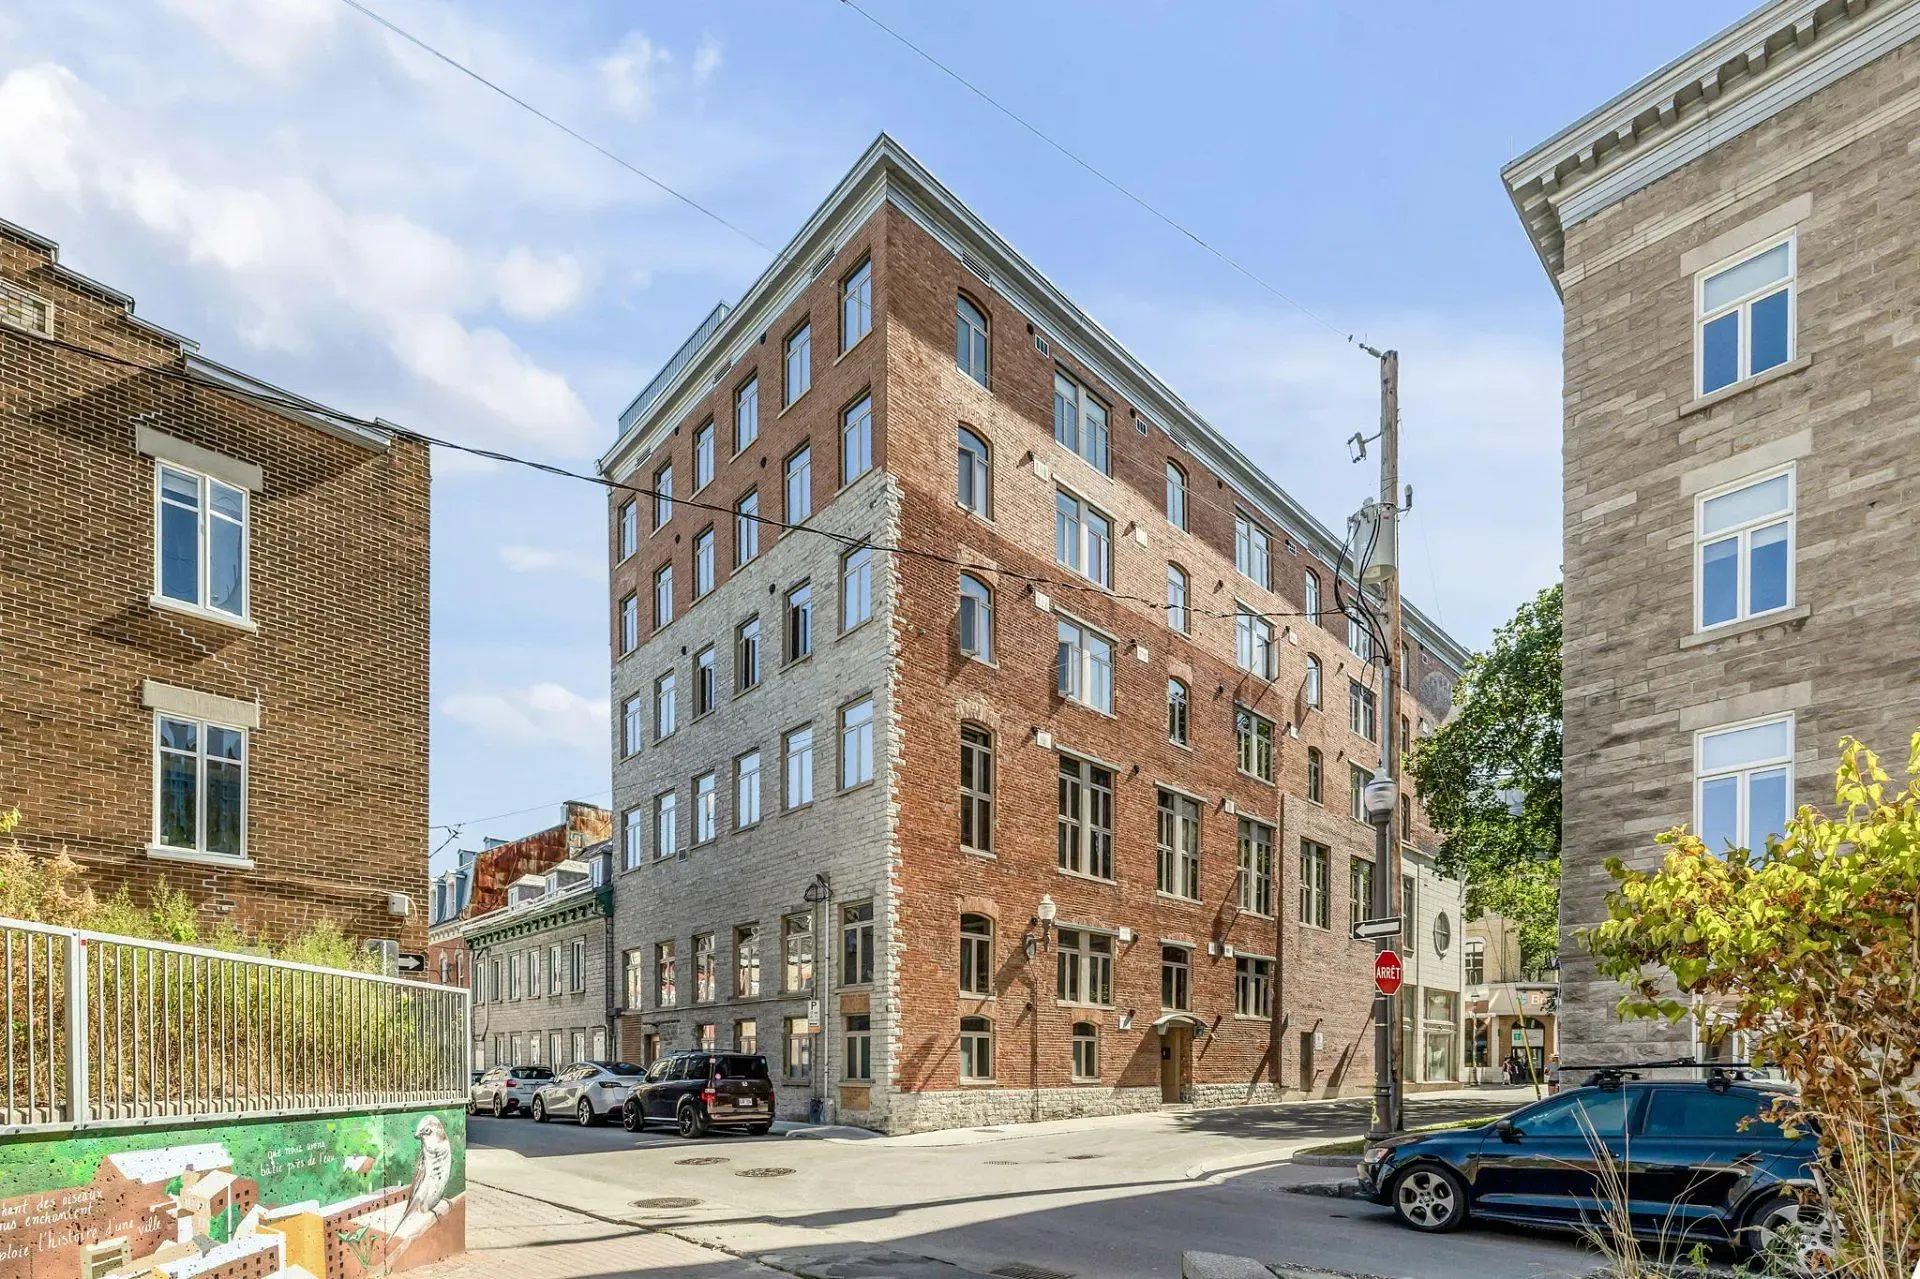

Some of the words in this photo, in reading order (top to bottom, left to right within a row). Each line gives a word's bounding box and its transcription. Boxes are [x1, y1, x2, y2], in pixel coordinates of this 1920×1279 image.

[1376, 964, 1401, 980] ARRÊT
[811, 1001, 818, 1011] P
[267, 1149, 282, 1166] que
[307, 1152, 317, 1167] de
[36, 1195, 57, 1213] des
[62, 1190, 104, 1206] oiseaux
[38, 1228, 98, 1252] l'histoire
[105, 1217, 134, 1236] d'une
[137, 1215, 161, 1236] ville
